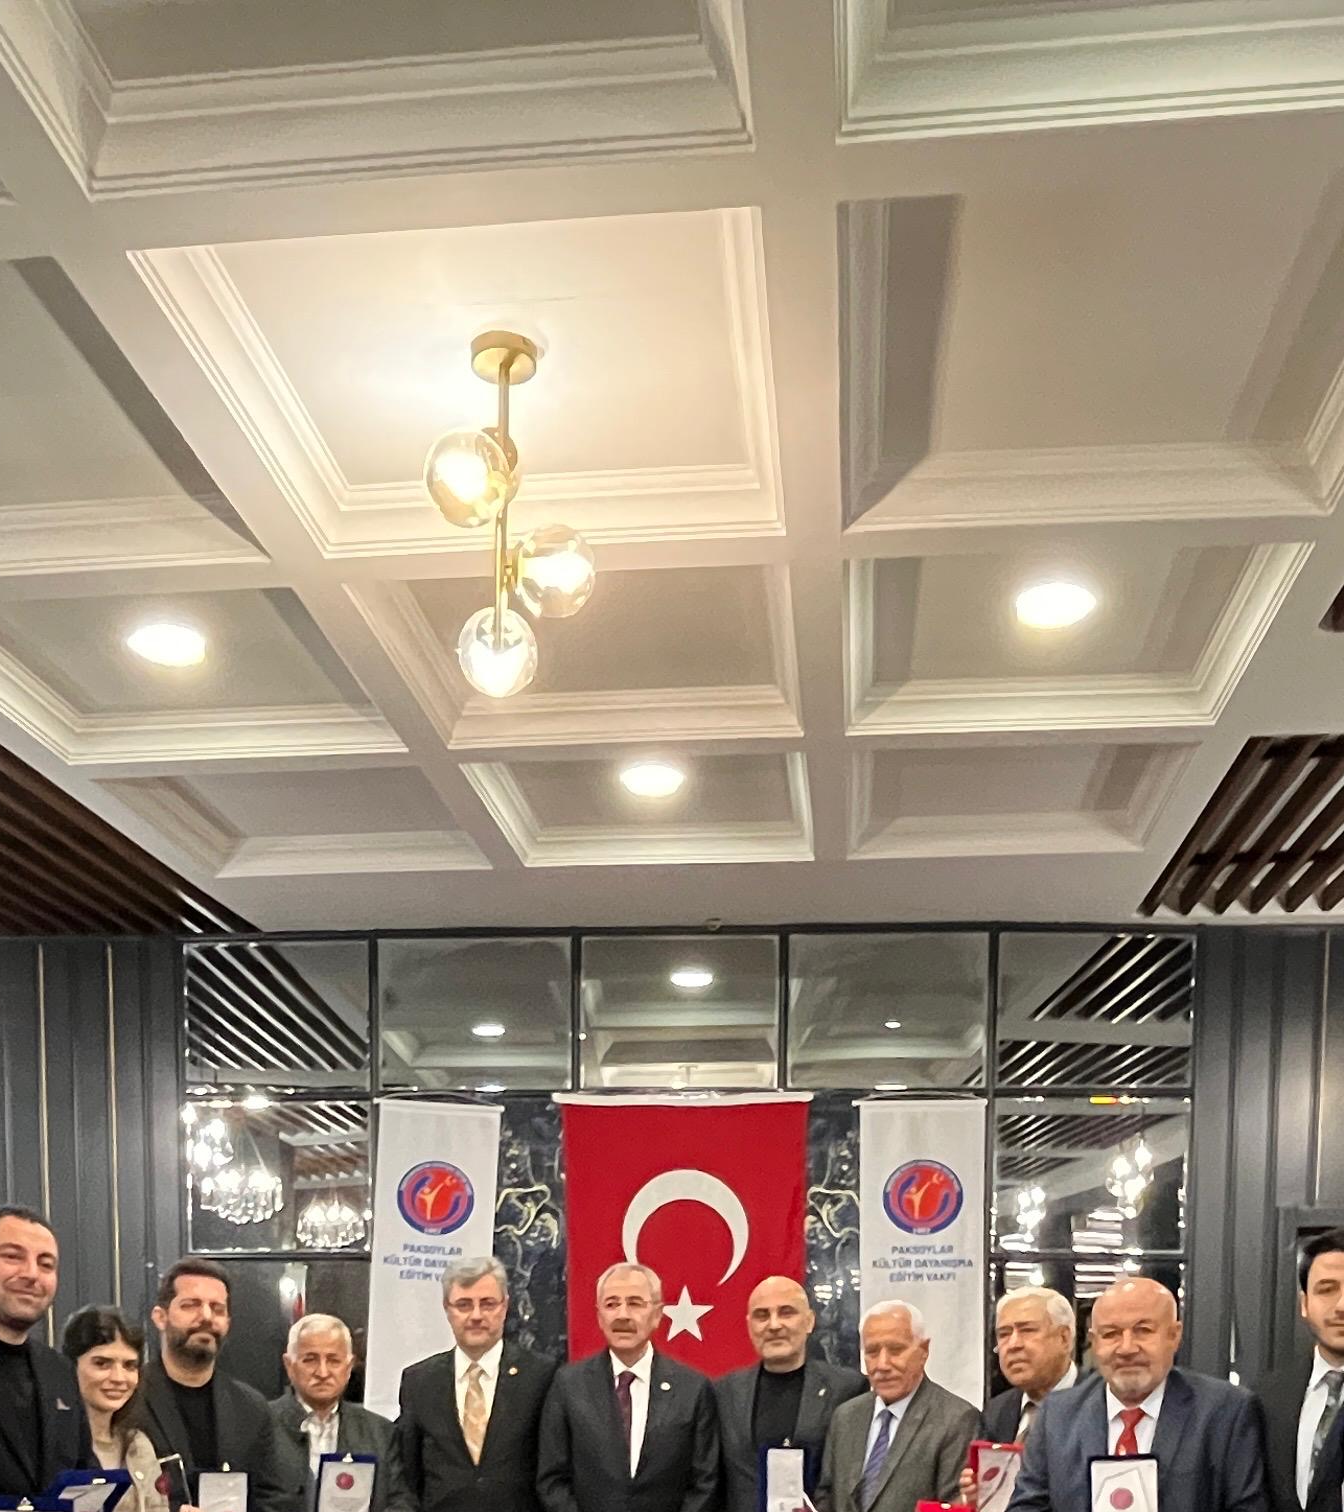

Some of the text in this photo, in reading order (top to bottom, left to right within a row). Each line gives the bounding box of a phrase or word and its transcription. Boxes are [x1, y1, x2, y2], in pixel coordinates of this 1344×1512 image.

[402, 1243, 463, 1256] PAKSOYLAR
[891, 1244, 954, 1255] PAKSOYLAR
[383, 1254, 422, 1267] KÜLTÜR
[872, 1257, 912, 1269] KÜLTÜR
